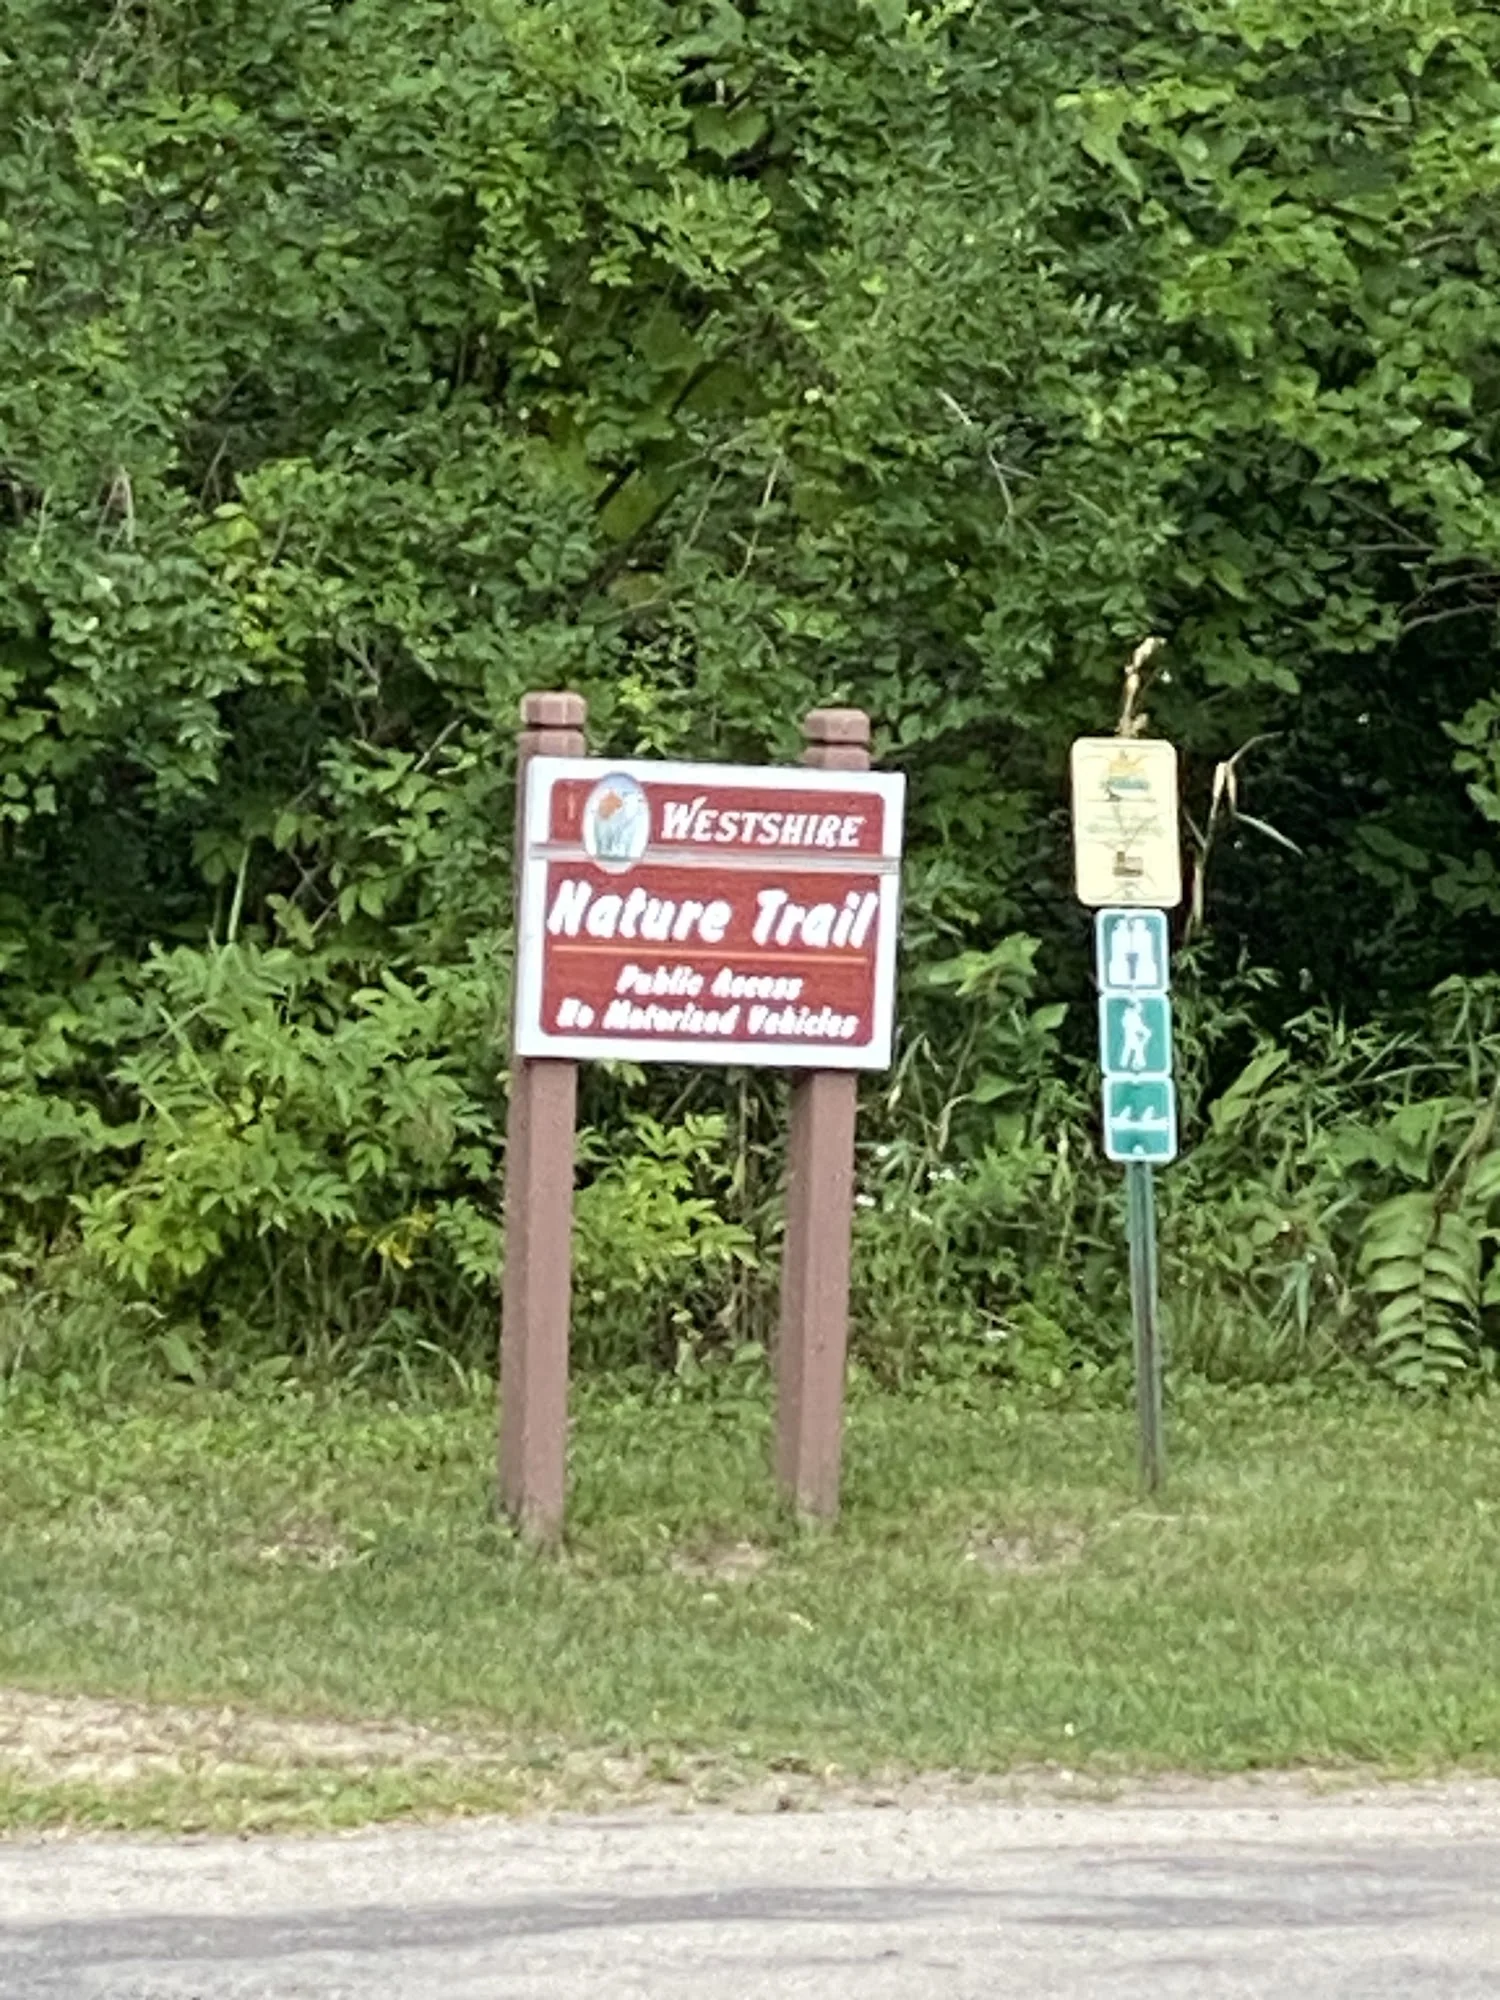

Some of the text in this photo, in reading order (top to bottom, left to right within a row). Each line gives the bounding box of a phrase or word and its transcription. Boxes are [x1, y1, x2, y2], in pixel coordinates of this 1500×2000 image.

[660, 797, 867, 848] WESTSHIRE
[548, 879, 878, 948] Nature Trail
[616, 965, 803, 1000] Public Access
[557, 998, 595, 1027] No
[747, 1006, 859, 1039] Vehicles
